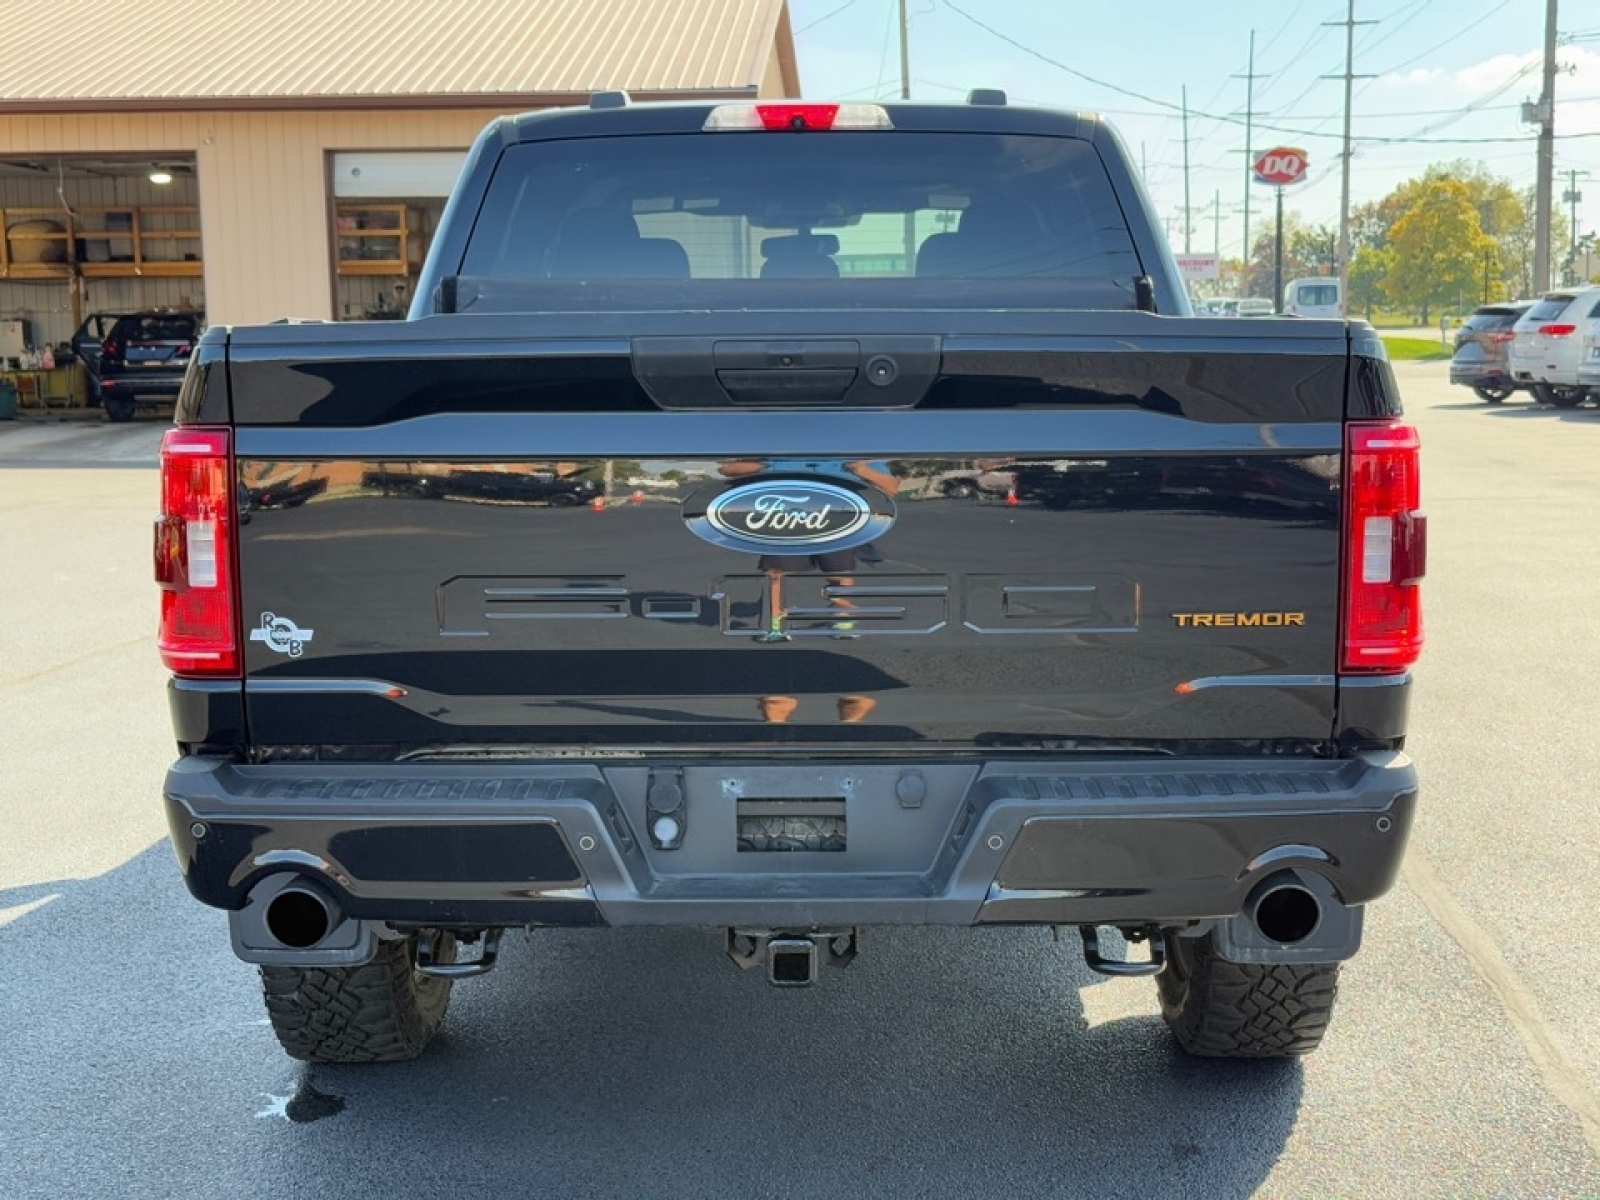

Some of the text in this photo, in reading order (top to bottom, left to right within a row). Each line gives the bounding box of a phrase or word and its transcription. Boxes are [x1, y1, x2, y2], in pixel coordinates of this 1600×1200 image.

[1262, 156, 1300, 176] DQ
[745, 494, 831, 530] Ford
[1171, 611, 1306, 627] TREMOR
